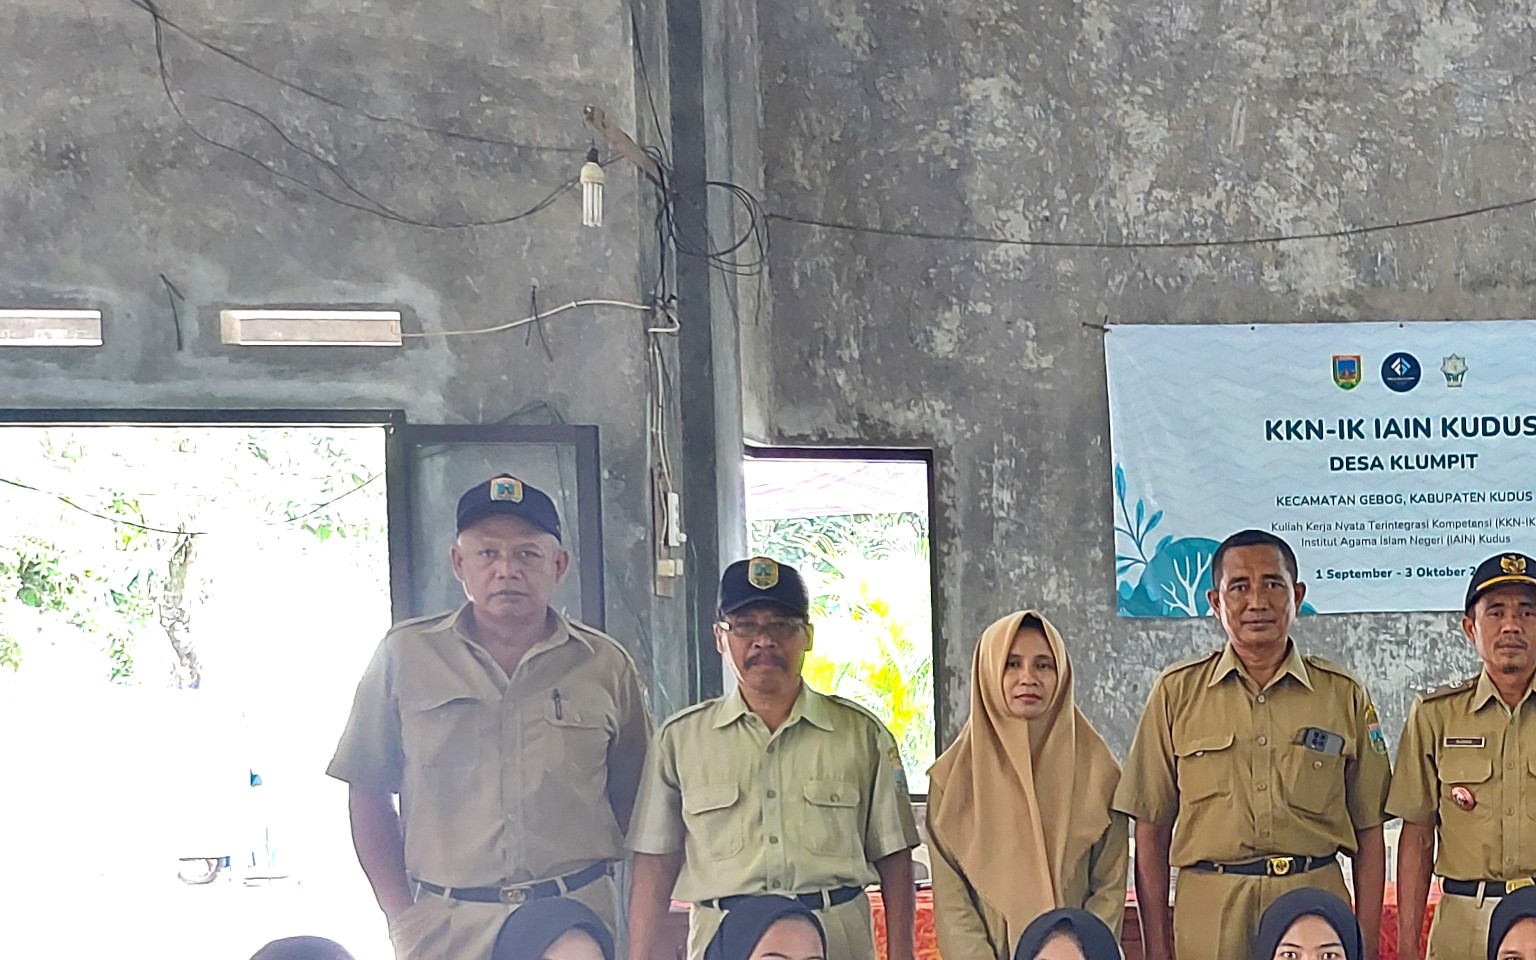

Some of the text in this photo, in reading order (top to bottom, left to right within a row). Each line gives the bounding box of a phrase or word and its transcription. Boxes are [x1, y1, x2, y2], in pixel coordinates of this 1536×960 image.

[1265, 418, 1365, 441] KKN-IK
[1374, 417, 1432, 440] IAIN
[1329, 453, 1479, 472] DESA KLUMPIT
[1276, 491, 1533, 507] KECAMATAN GEBOG, KABUPATEN KUDUS
[1271, 522, 1303, 532] Kuliah
[1306, 521, 1332, 533] Kerja
[1335, 521, 1366, 532] Nyata
[1368, 519, 1429, 531] Terintegrasi
[1432, 518, 1492, 530] Kompetensi
[1301, 533, 1511, 548] Institut Agama Islam Negeri (IAIN) Kudus
[1315, 569, 1324, 579] 1
[1326, 568, 1393, 581] September
[1405, 567, 1412, 578] 3
[1416, 567, 1466, 577] Oktober
